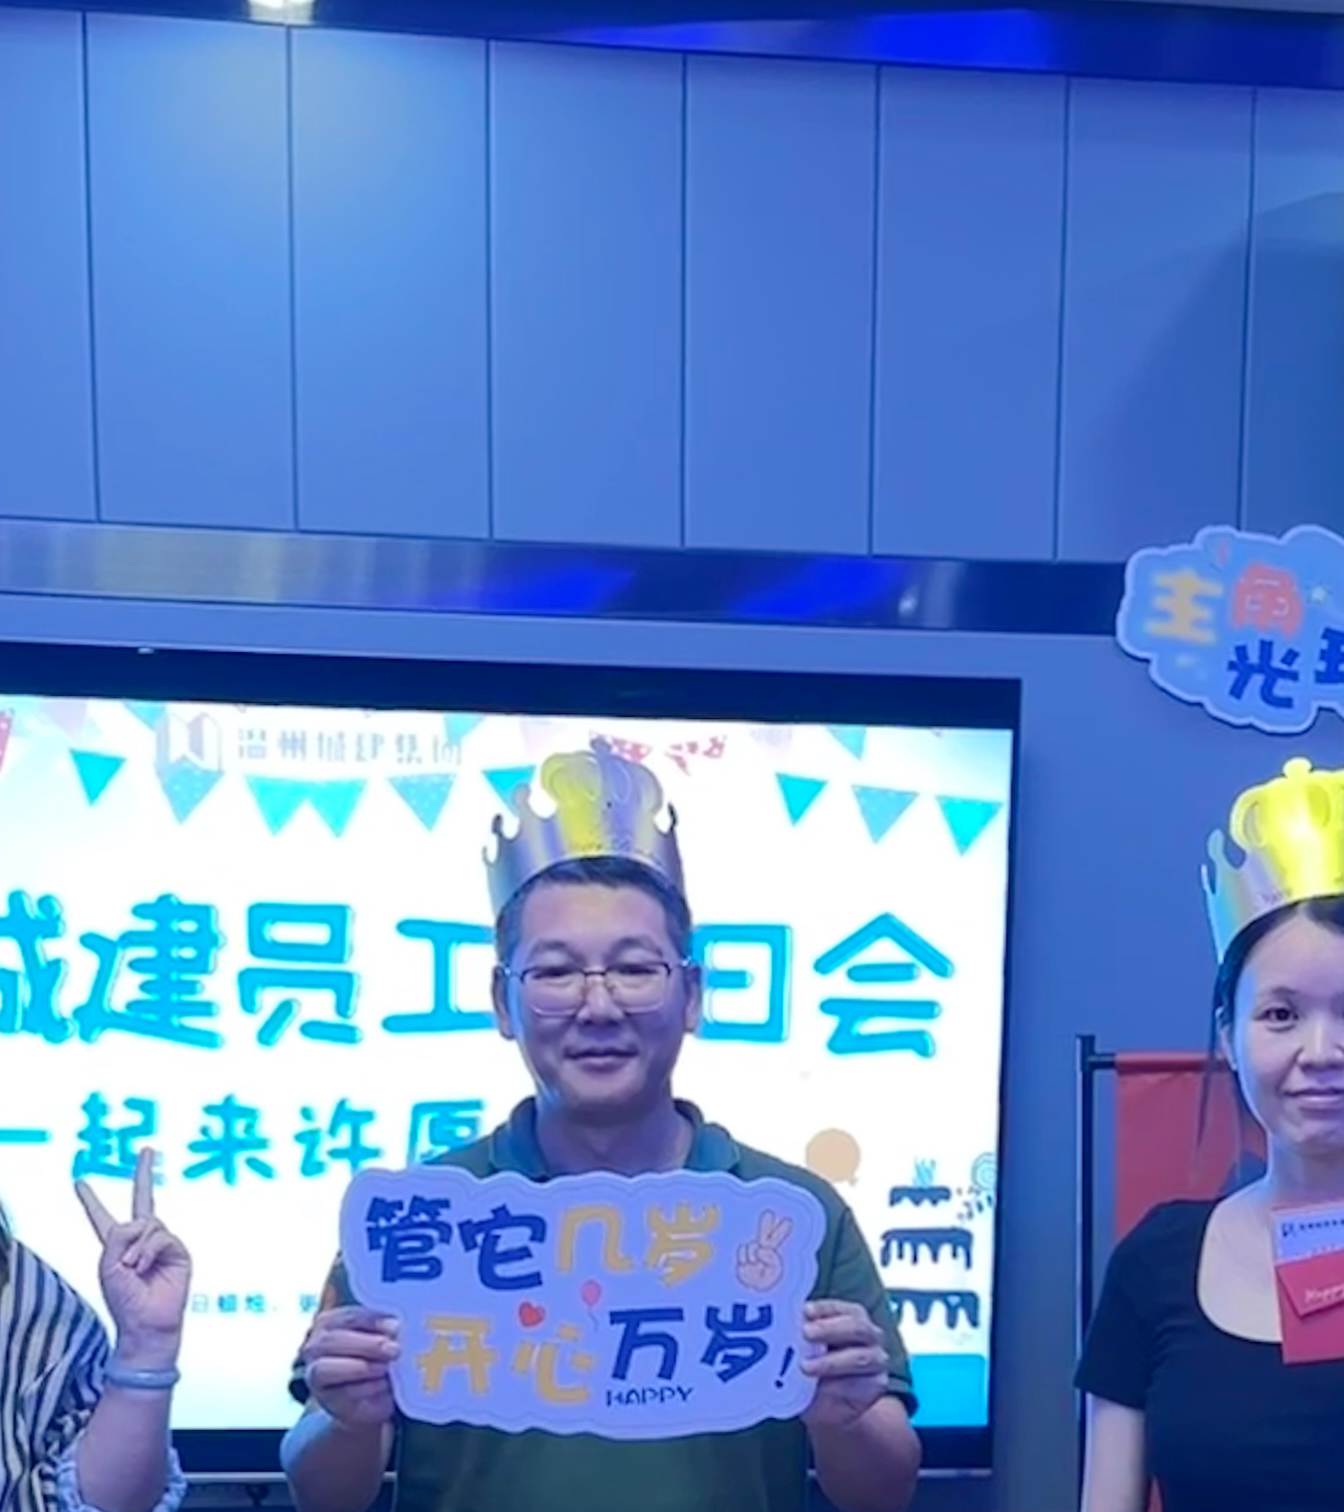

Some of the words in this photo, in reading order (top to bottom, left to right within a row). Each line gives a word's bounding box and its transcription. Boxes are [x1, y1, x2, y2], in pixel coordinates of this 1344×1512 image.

[365, 1195, 721, 1291] 管它几岁
[605, 1386, 694, 1407] HAPPY
